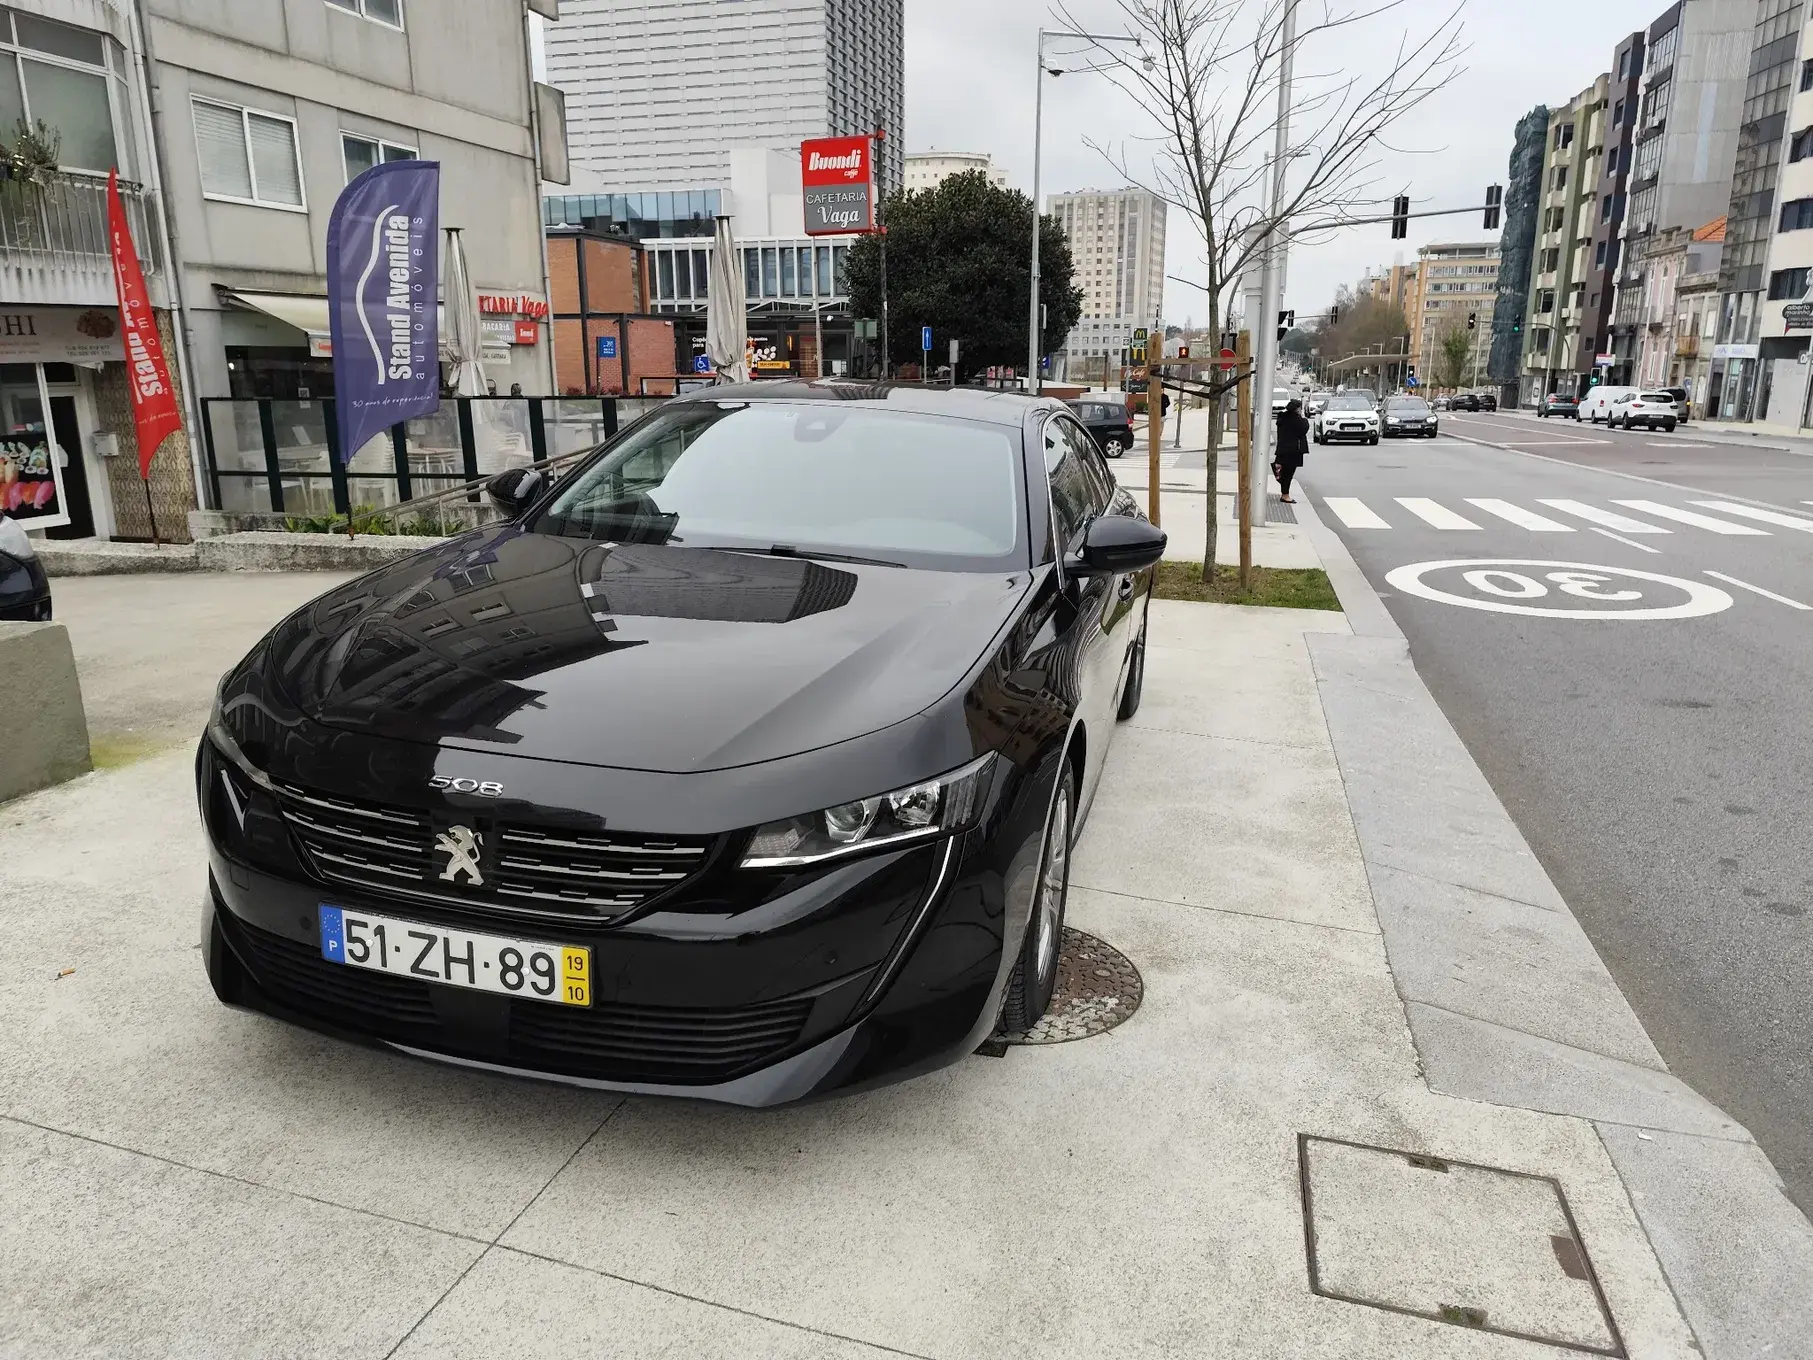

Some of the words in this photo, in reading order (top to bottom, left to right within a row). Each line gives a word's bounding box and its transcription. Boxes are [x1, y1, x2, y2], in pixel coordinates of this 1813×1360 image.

[809, 149, 862, 171] Buondi
[806, 192, 867, 204] CAFETARIA
[817, 206, 861, 228] Vaga
[385, 215, 410, 310] Avenida
[411, 217, 425, 380] automóveis
[521, 295, 549, 318] Vaga
[387, 313, 412, 380] Stand
[352, 400, 364, 408] 30
[1462, 570, 1643, 600] 30
[428, 774, 504, 797] 508
[329, 940, 338, 951] P
[566, 955, 583, 971] 19
[567, 986, 584, 1001] 10
